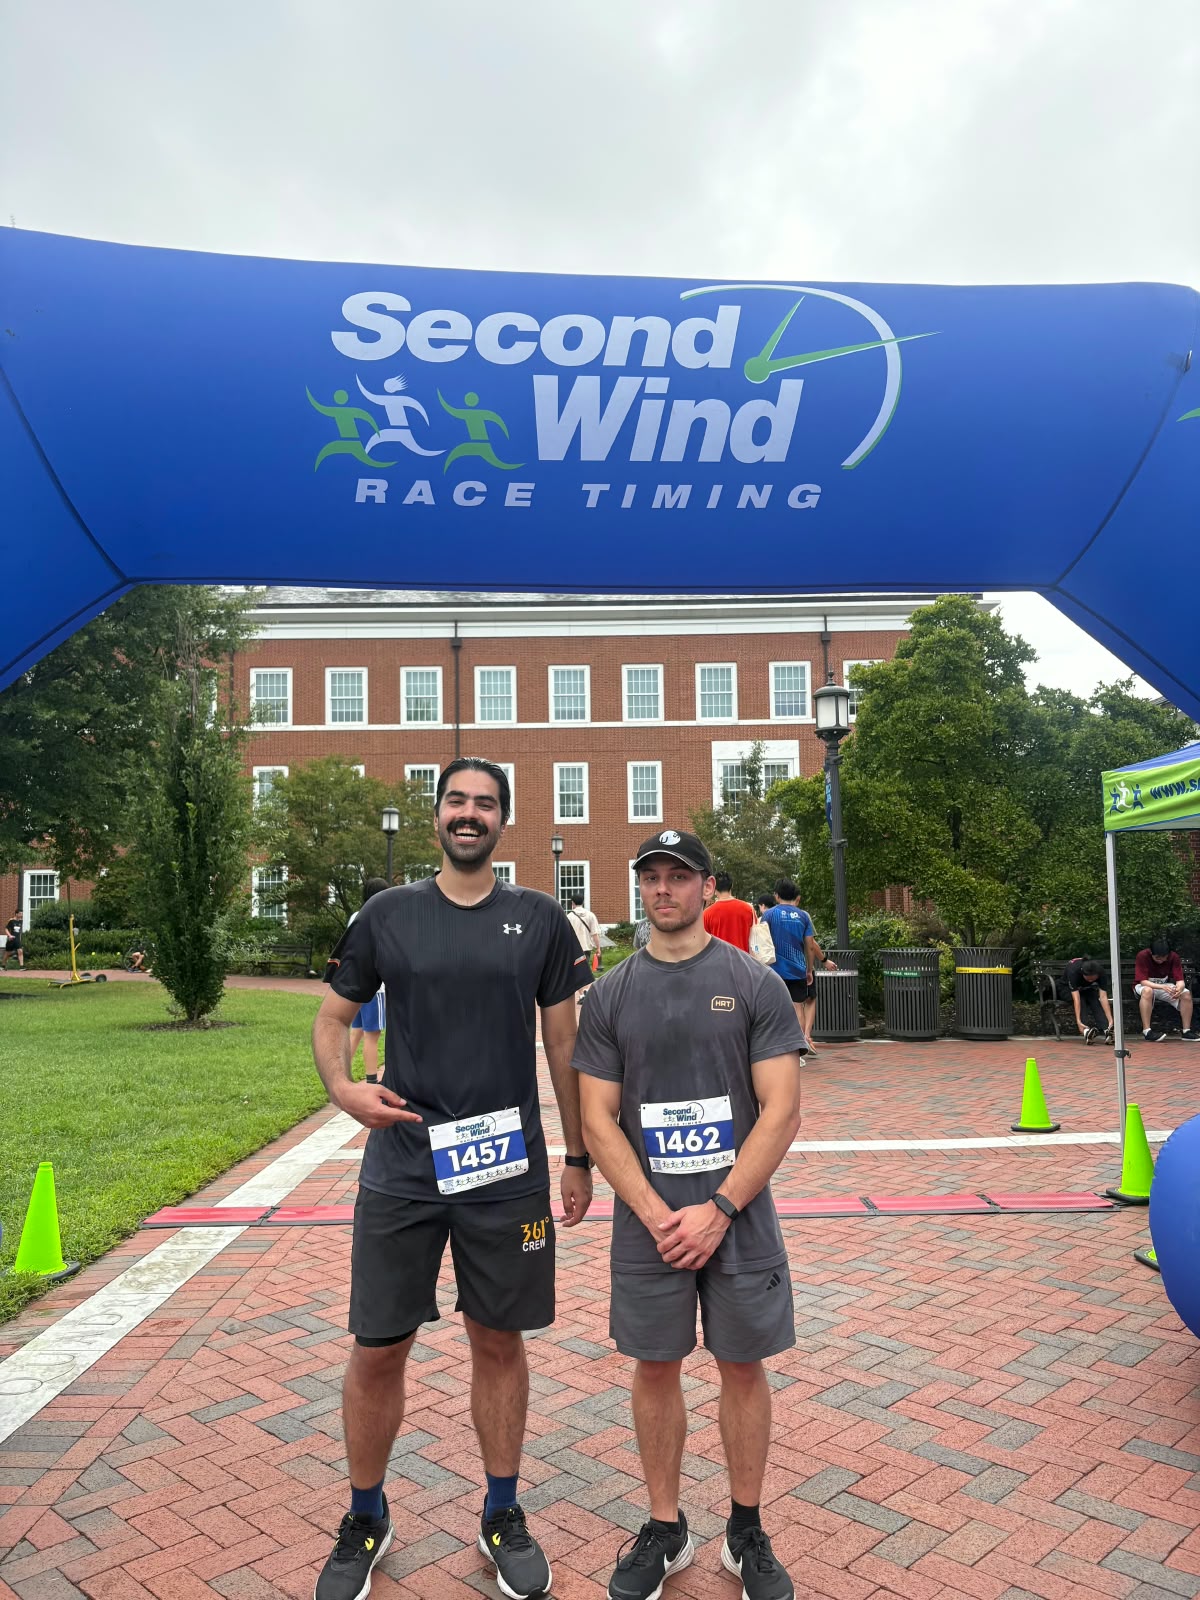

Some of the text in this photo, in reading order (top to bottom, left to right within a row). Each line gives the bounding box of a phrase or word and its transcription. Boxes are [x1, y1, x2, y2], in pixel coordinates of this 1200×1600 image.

[331, 291, 741, 369] Second
[533, 375, 804, 464] Wind
[355, 478, 822, 510] RACE TIMING
[663, 1106, 692, 1116] Second
[676, 1113, 697, 1122] Wind
[455, 1120, 485, 1133] Second
[470, 1126, 490, 1137] Wind
[655, 1126, 721, 1154] 1462
[448, 1136, 510, 1172] 1457
[522, 1237, 546, 1252] CREW
